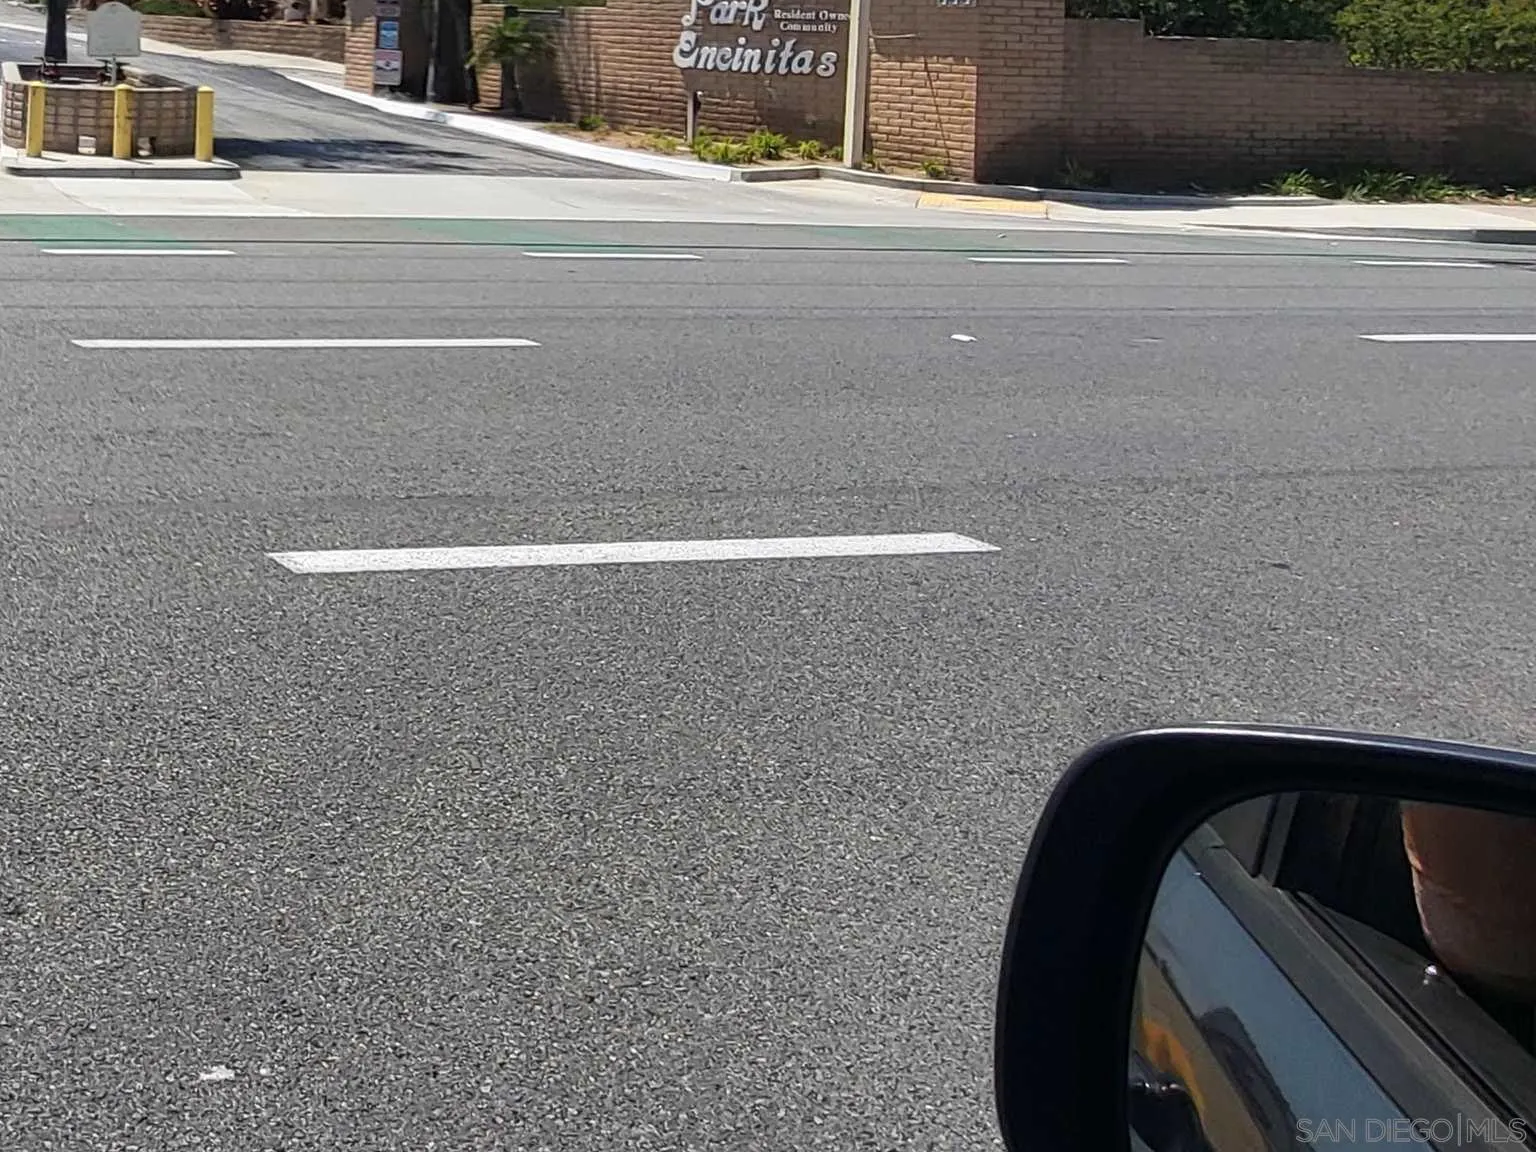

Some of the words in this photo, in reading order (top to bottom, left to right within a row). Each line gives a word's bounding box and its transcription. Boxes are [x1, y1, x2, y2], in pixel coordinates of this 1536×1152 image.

[773, 9, 816, 20] Resident
[818, 10, 850, 21] Owne
[779, 21, 838, 34] Community
[673, 30, 839, 78] Encinitas
